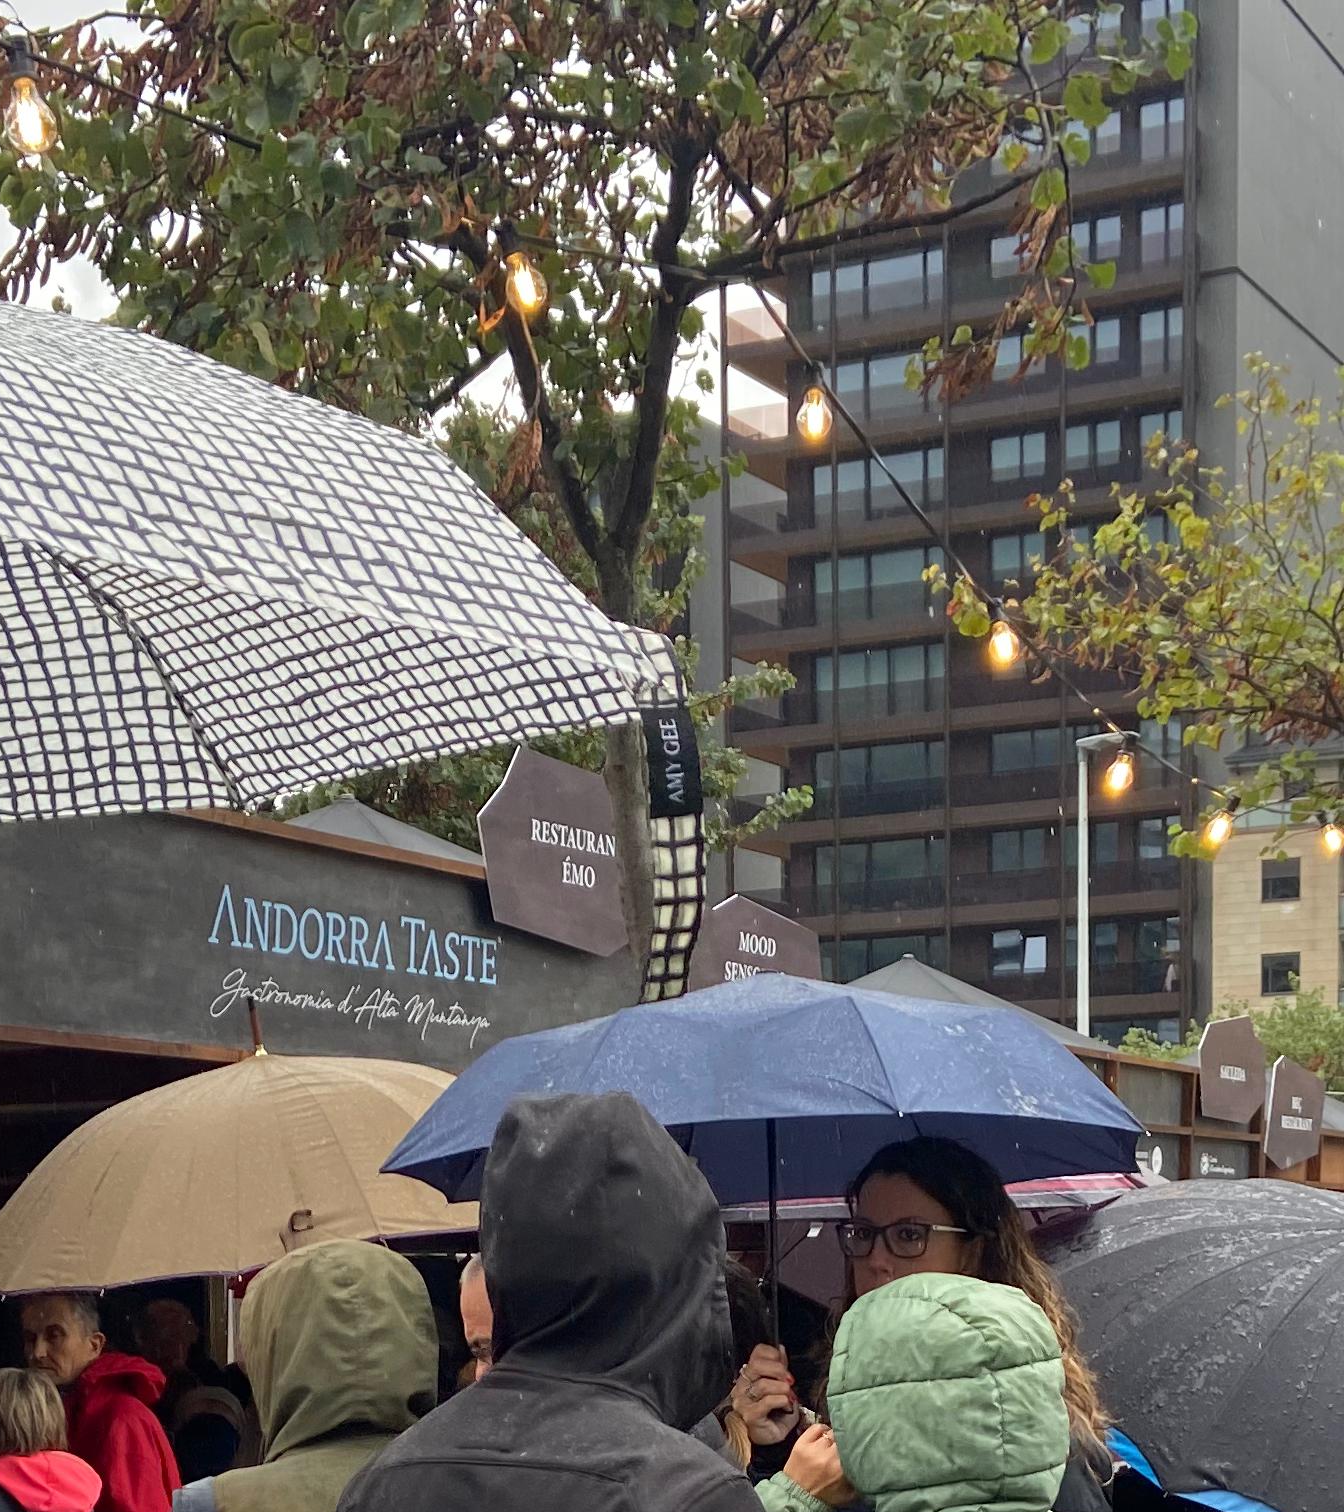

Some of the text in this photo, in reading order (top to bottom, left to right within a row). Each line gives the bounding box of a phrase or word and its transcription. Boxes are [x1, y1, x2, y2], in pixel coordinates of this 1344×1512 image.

[659, 718, 685, 804] AMY GEE
[531, 818, 616, 857] RESTAURAN
[562, 856, 596, 888] ÉMO
[208, 884, 497, 985] ANDORRA TASTE
[738, 931, 777, 957] MOOD
